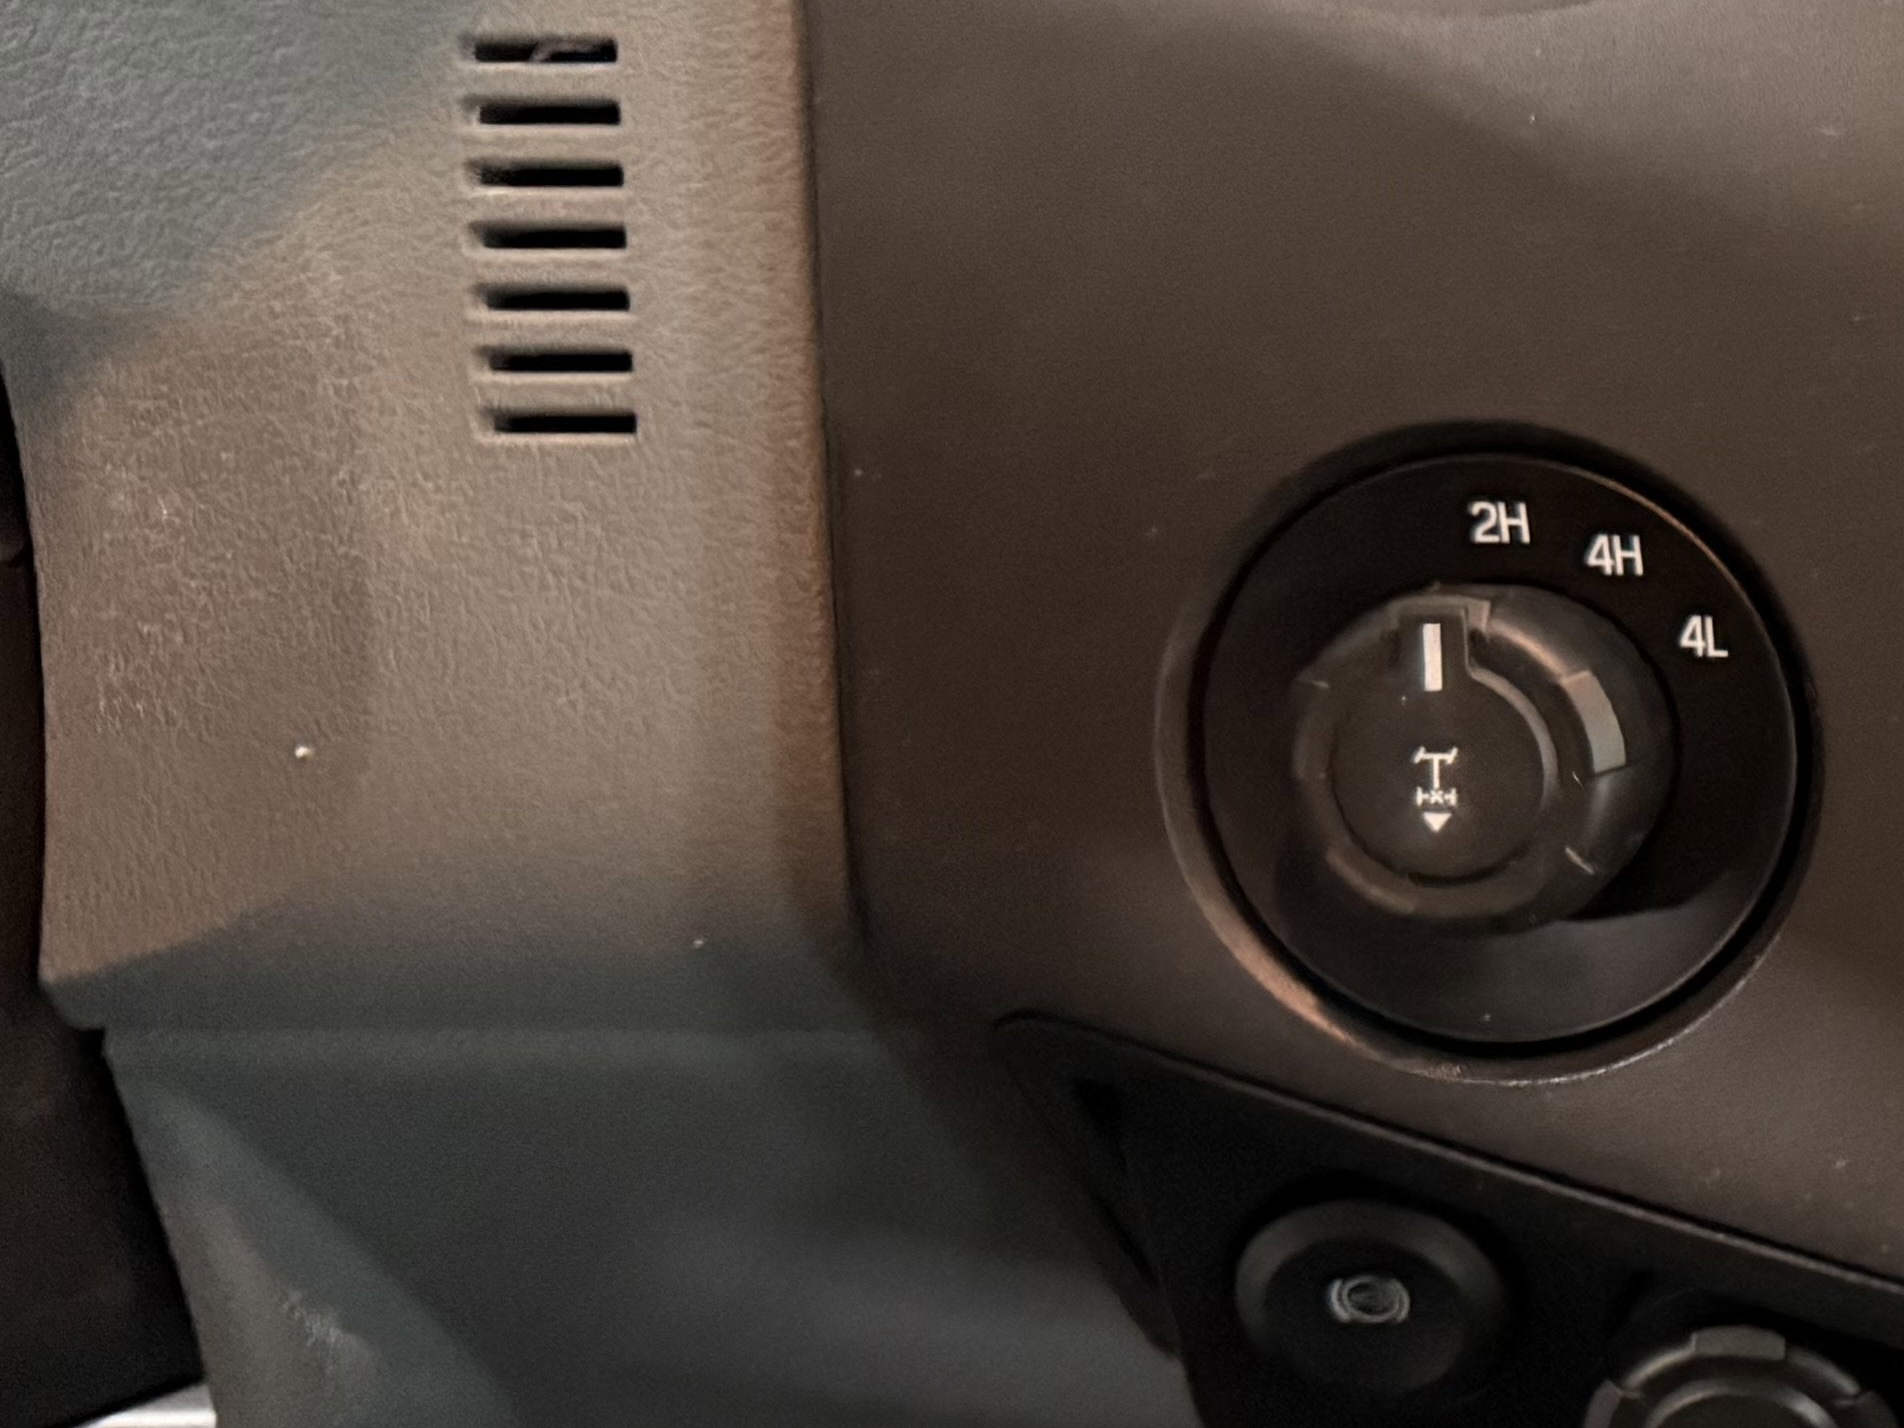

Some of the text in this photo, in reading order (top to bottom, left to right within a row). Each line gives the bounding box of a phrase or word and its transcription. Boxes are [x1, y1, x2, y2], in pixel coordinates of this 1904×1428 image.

[1468, 500, 1531, 545] 2H
[1584, 533, 1645, 577] 4H
[1677, 614, 1730, 659] 4L
